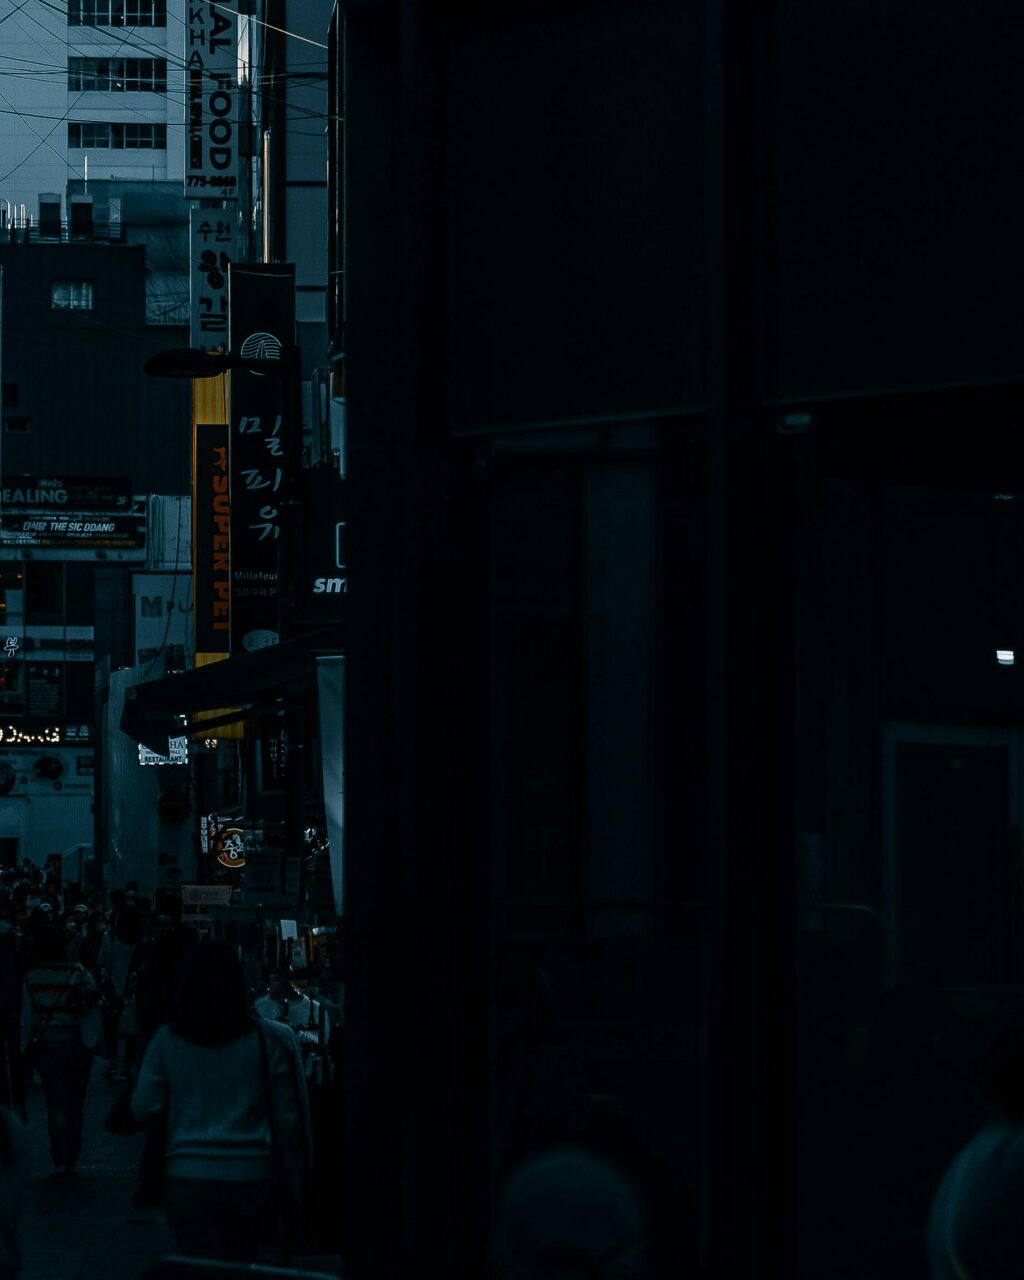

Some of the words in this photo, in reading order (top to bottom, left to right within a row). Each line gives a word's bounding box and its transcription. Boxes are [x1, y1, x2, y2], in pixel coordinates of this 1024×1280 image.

[209, 73, 232, 170] FOOD
[197, 221, 231, 242] 수원
[50, 522, 68, 532] THE
[212, 475, 231, 572] SUPER
[212, 581, 231, 631] PET
